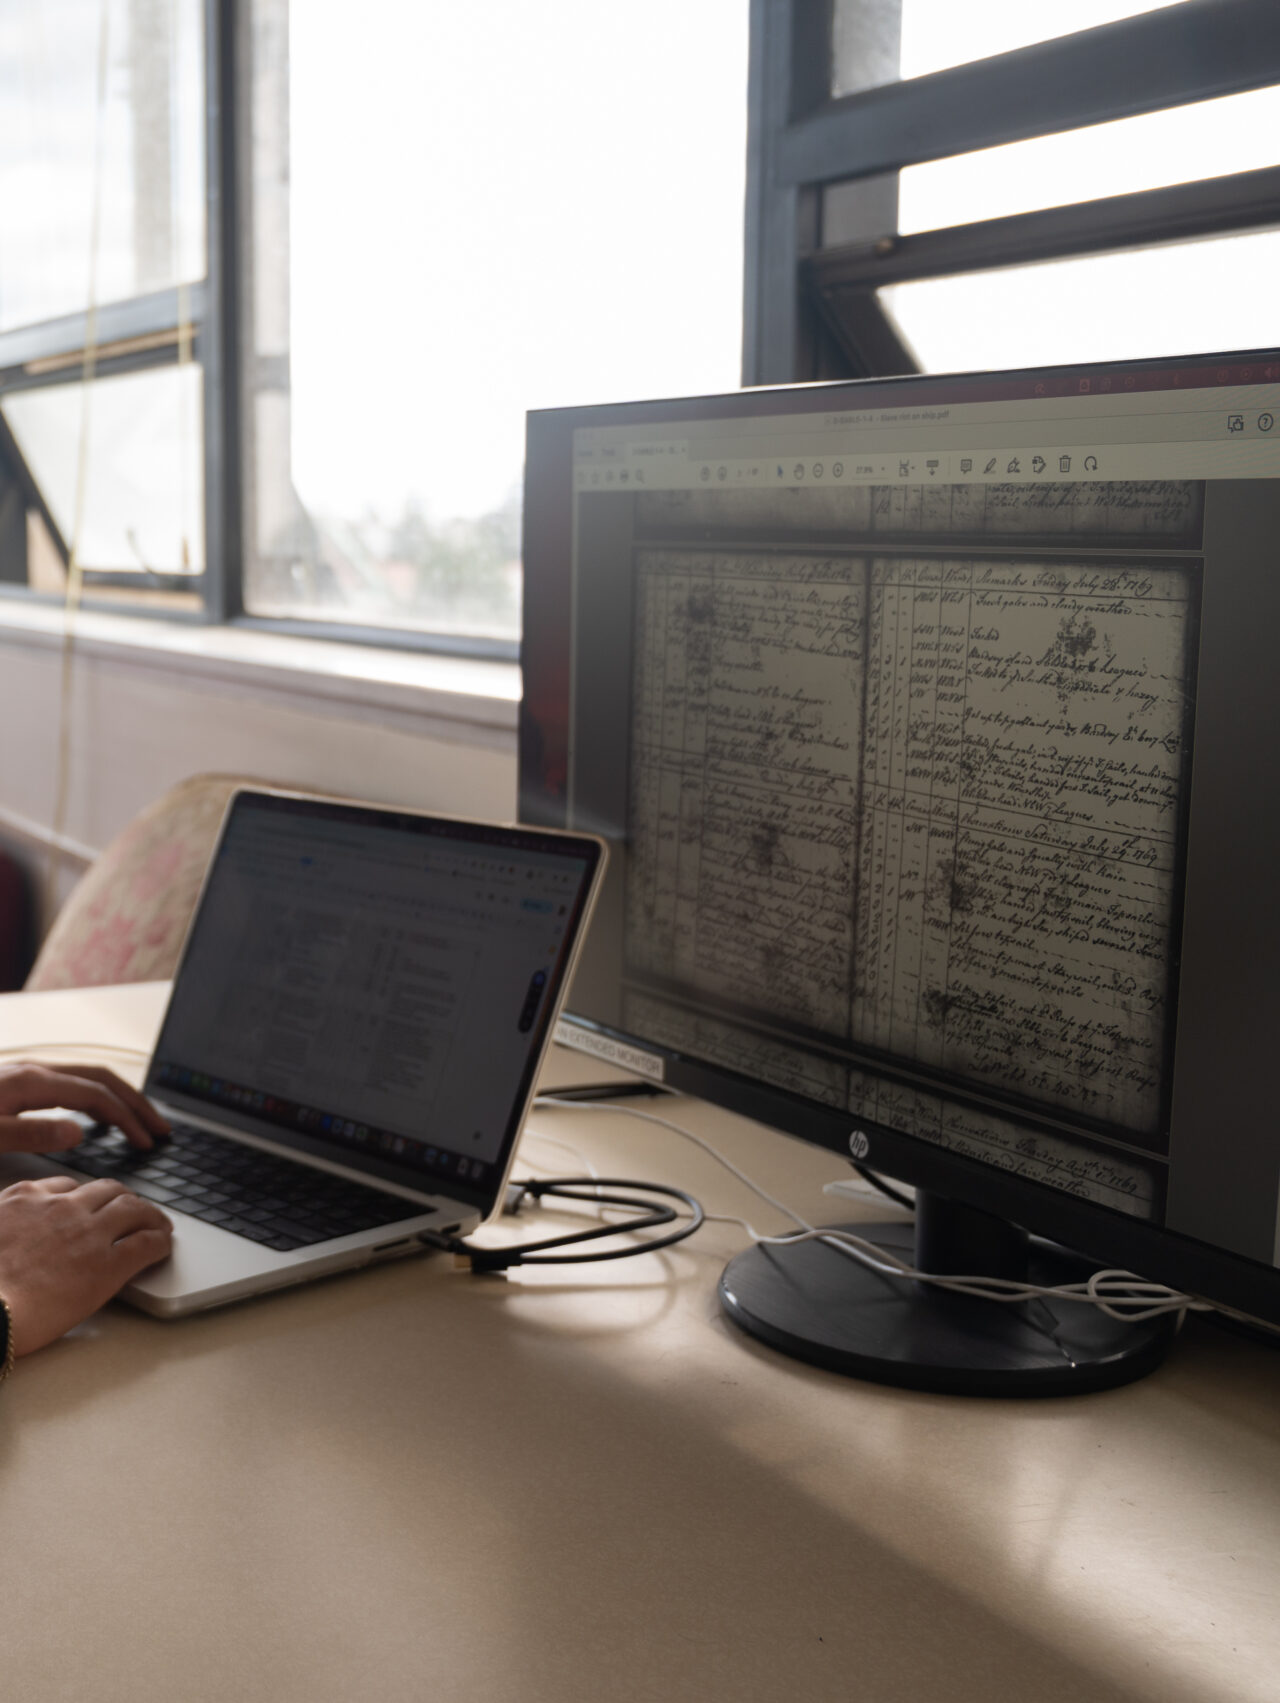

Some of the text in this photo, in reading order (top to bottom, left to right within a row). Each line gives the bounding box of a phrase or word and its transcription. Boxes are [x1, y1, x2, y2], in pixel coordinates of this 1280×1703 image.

[1031, 572, 1072, 594] Friday
[1072, 573, 1100, 595] July
[1023, 823, 1079, 854] Saturday
[1079, 835, 1110, 859] July
[1132, 847, 1158, 868] 1769
[1066, 872, 1112, 899] Leagues
[570, 1029, 616, 1058] EXTENDED
[616, 1046, 661, 1074] MONITOR
[850, 1131, 867, 1158] hp
